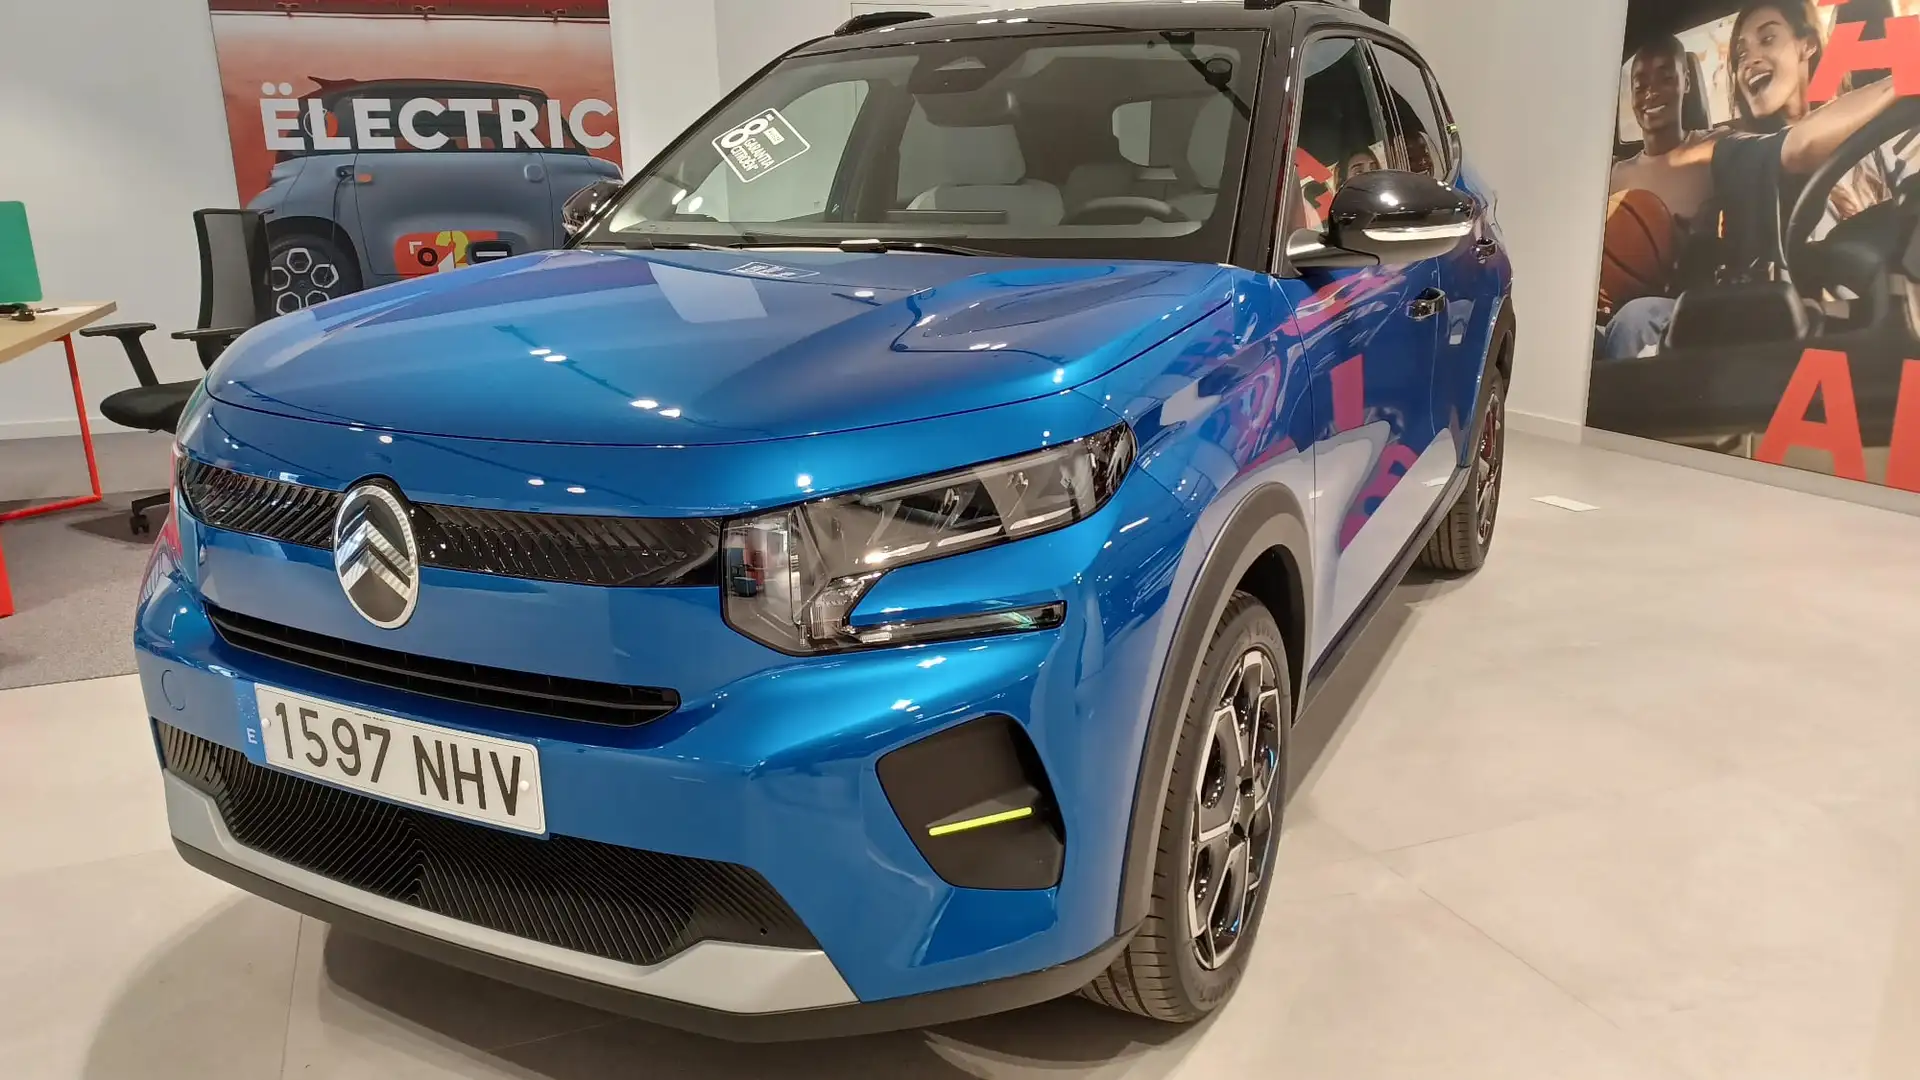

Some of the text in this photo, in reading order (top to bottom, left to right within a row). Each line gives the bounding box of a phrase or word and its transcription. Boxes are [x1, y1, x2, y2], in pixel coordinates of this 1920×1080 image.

[260, 82, 618, 151] ËLECTRIC
[720, 118, 768, 148] 8
[730, 145, 759, 171] CITROËN
[246, 727, 258, 744] E
[275, 702, 521, 816] 1597 NHV
